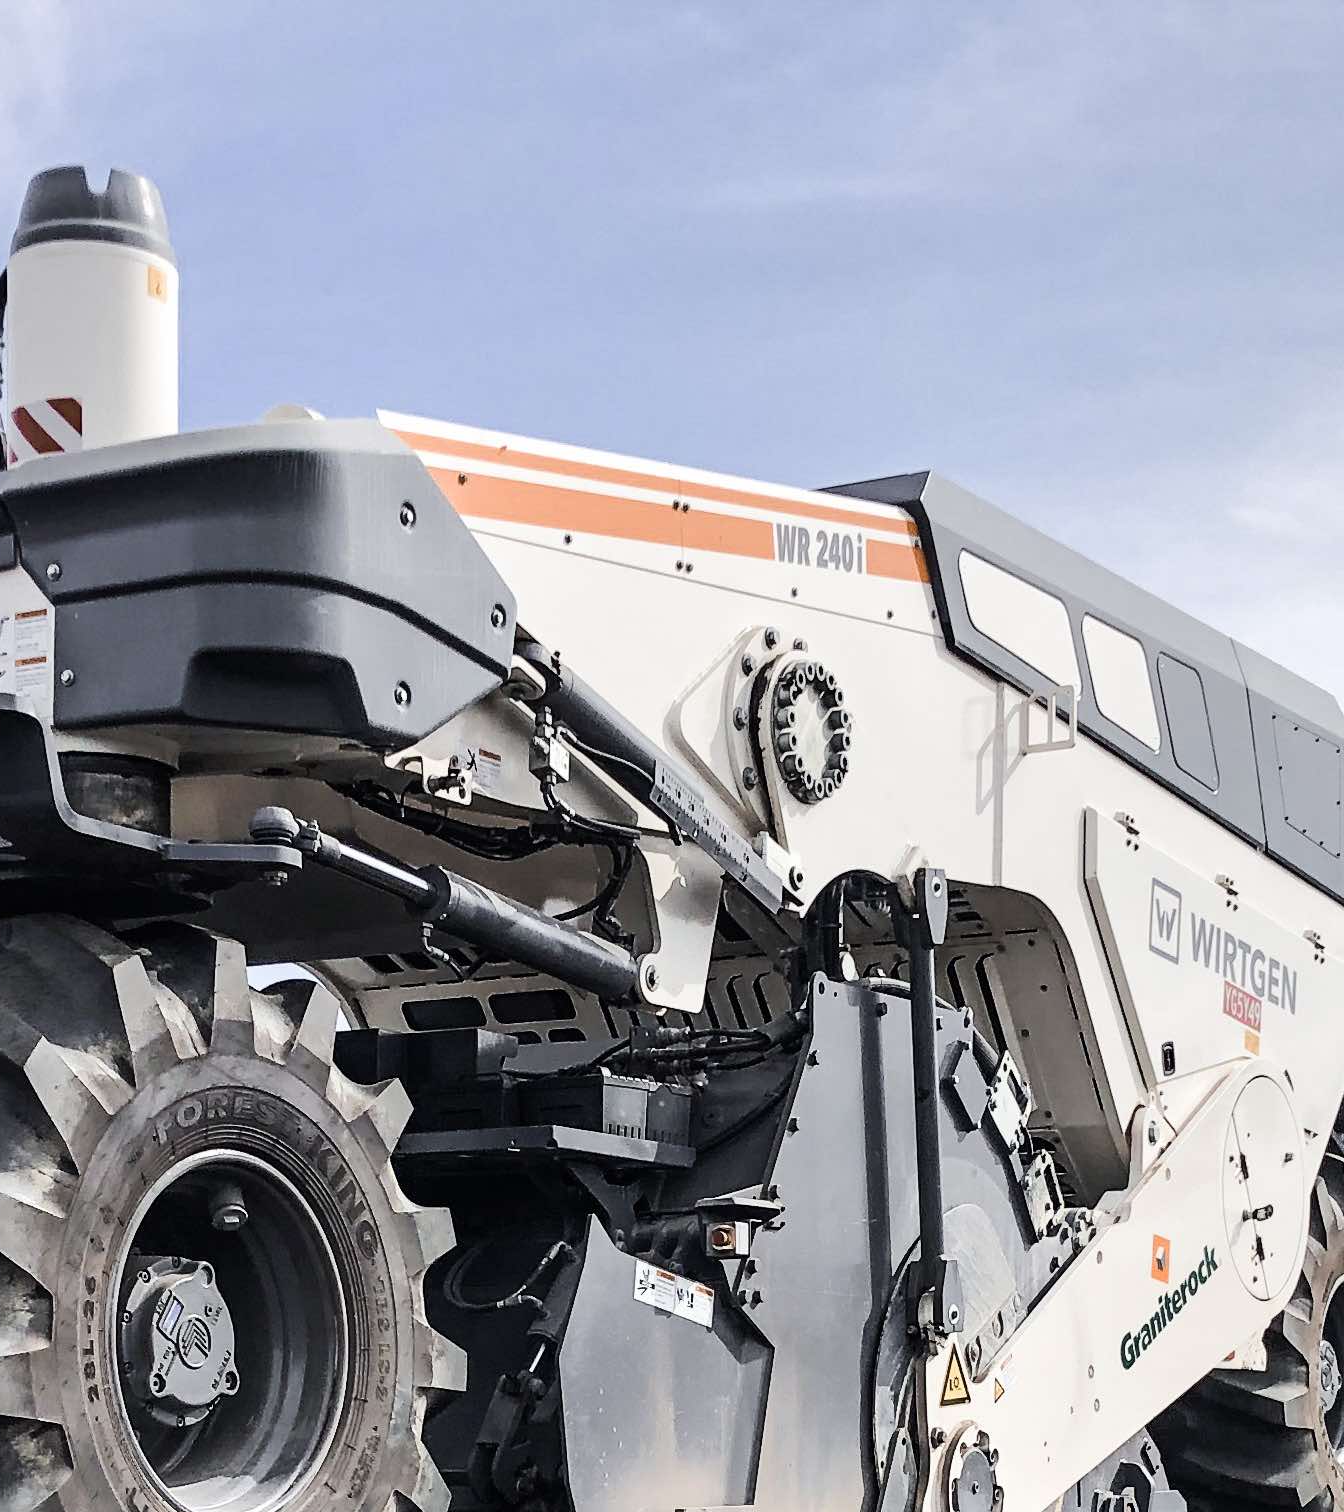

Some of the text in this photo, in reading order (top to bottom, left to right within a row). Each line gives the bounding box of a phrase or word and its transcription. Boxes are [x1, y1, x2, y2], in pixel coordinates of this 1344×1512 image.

[776, 523, 863, 574] WR 240i
[1190, 911, 1298, 1016] WIRTGEN
[153, 1088, 379, 1260] FOREST KING
[82, 1274, 100, 1403] 28L-26
[1120, 1244, 1219, 1371] Graniterock
